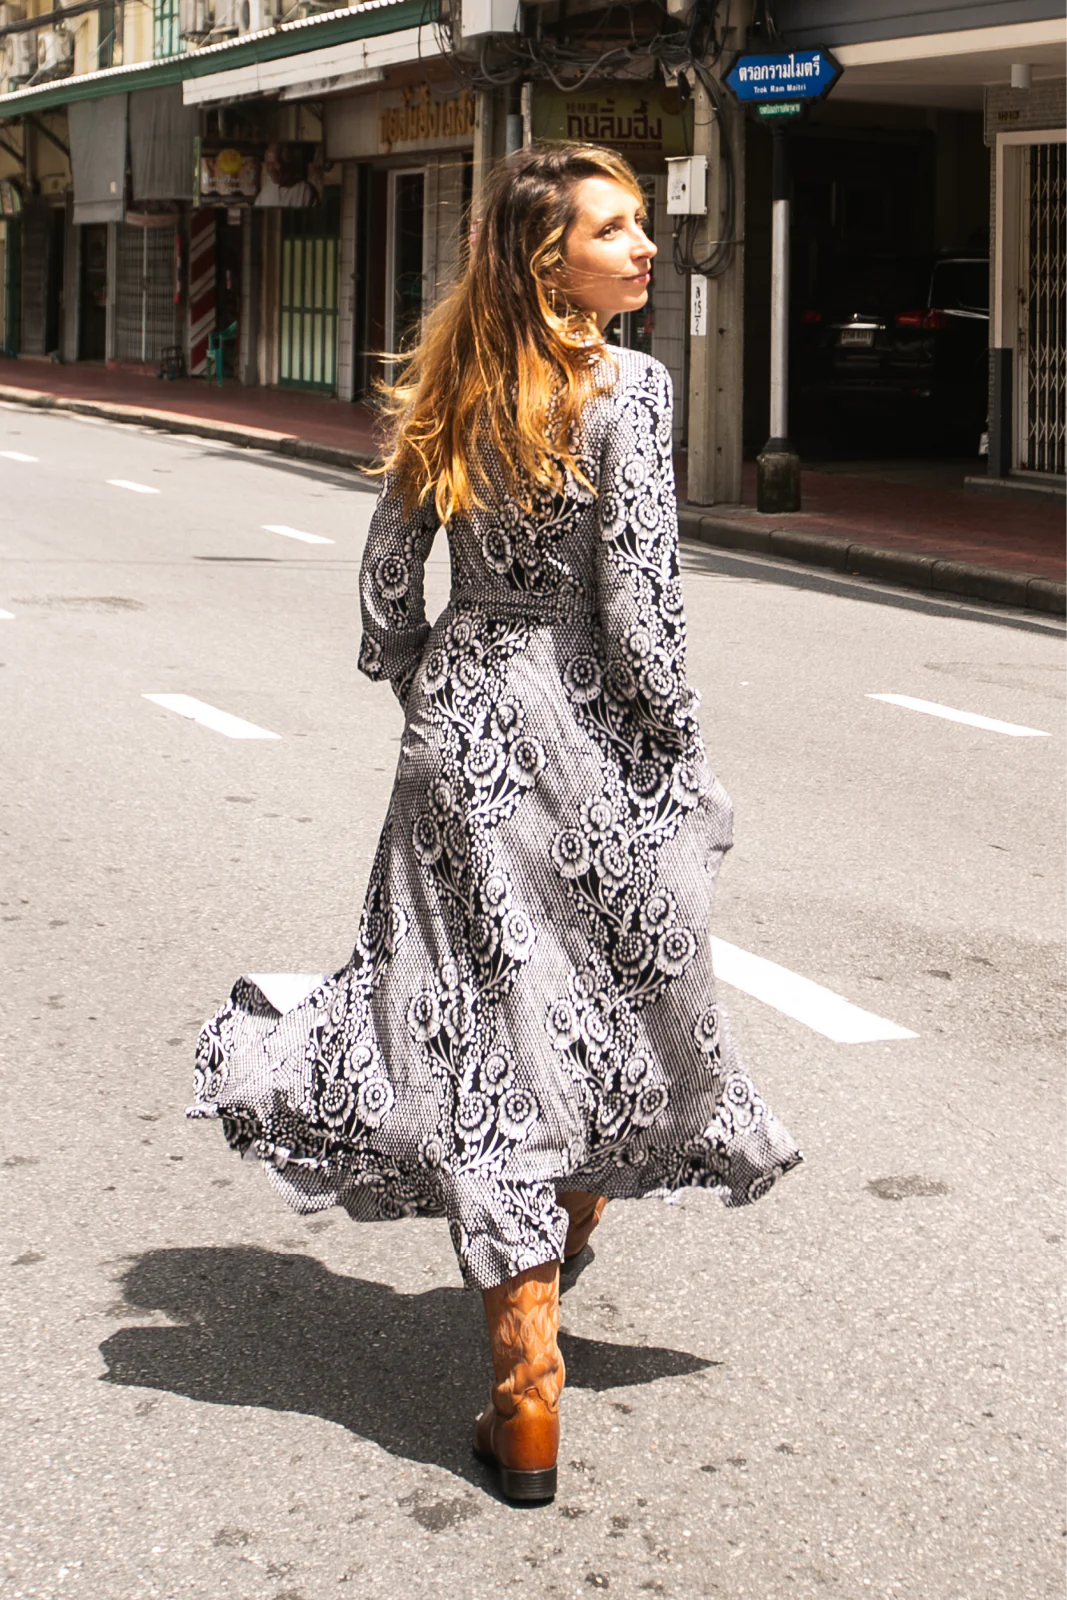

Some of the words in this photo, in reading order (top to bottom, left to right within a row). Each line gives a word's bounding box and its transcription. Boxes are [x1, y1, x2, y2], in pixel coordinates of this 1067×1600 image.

[738, 54, 820, 81] ตรอกรามไมตรี
[754, 86, 767, 94] Trok
[770, 85, 785, 93] Ram
[787, 84, 806, 92] Maitri
